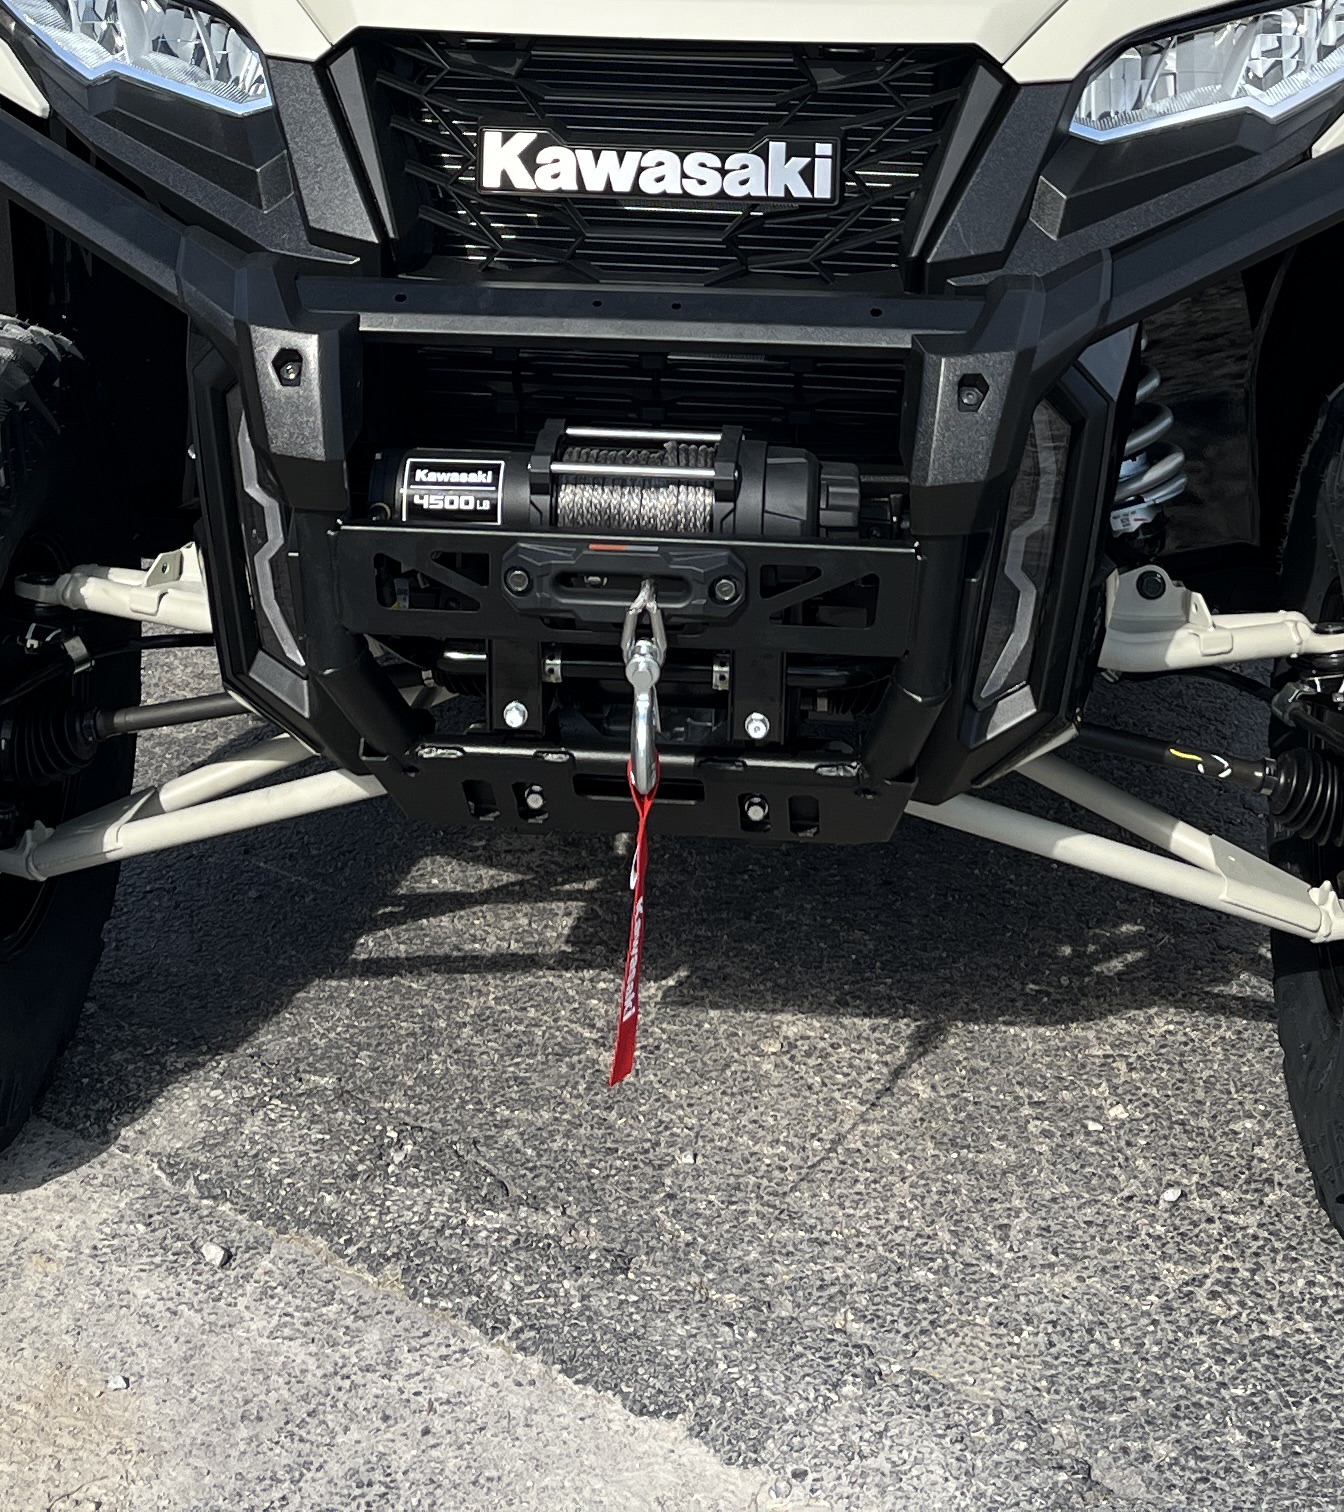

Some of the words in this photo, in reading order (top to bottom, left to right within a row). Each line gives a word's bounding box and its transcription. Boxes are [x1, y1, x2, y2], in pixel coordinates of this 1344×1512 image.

[481, 131, 833, 199] Kawasaki
[415, 468, 493, 483] Kawasaki
[413, 494, 475, 510] 4500
[476, 499, 491, 510] LB
